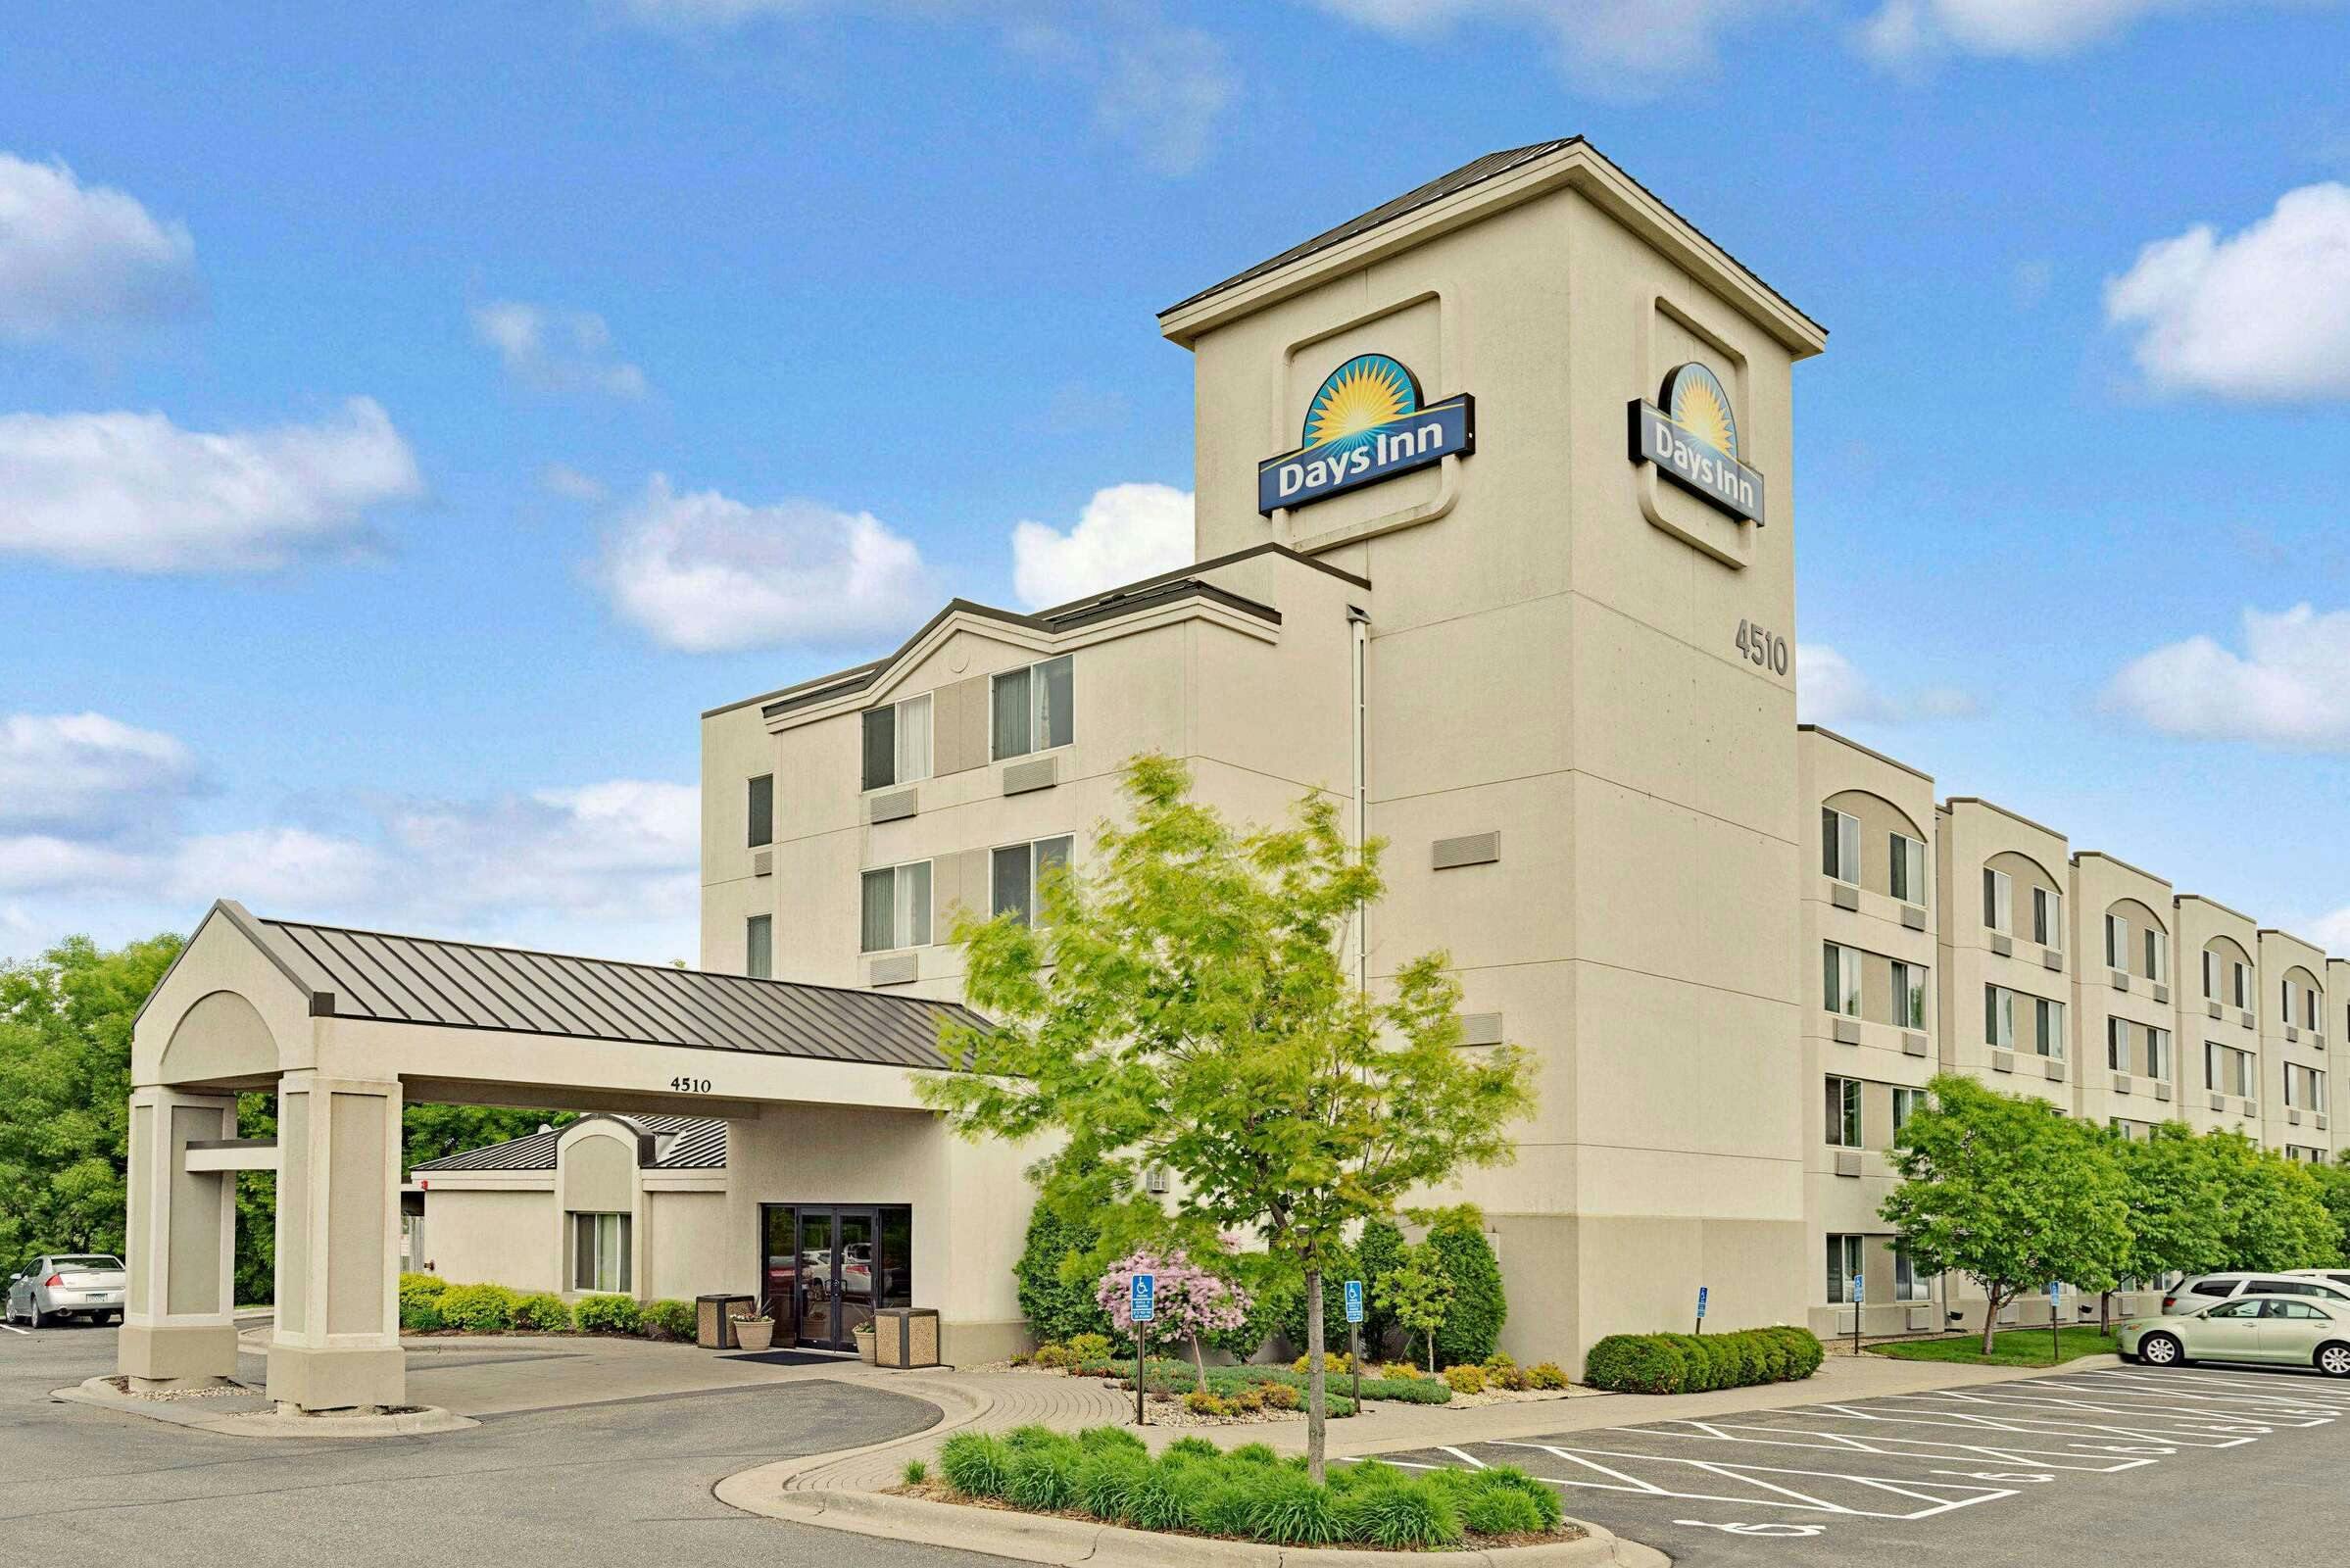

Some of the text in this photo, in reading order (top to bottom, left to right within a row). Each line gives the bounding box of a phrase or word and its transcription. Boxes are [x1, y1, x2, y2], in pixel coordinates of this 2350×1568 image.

[1279, 422, 1443, 497] Days Inn
[1656, 421, 1753, 508] Days Inn
[1735, 618, 1788, 676] 4510
[670, 1076, 711, 1093] 4510
